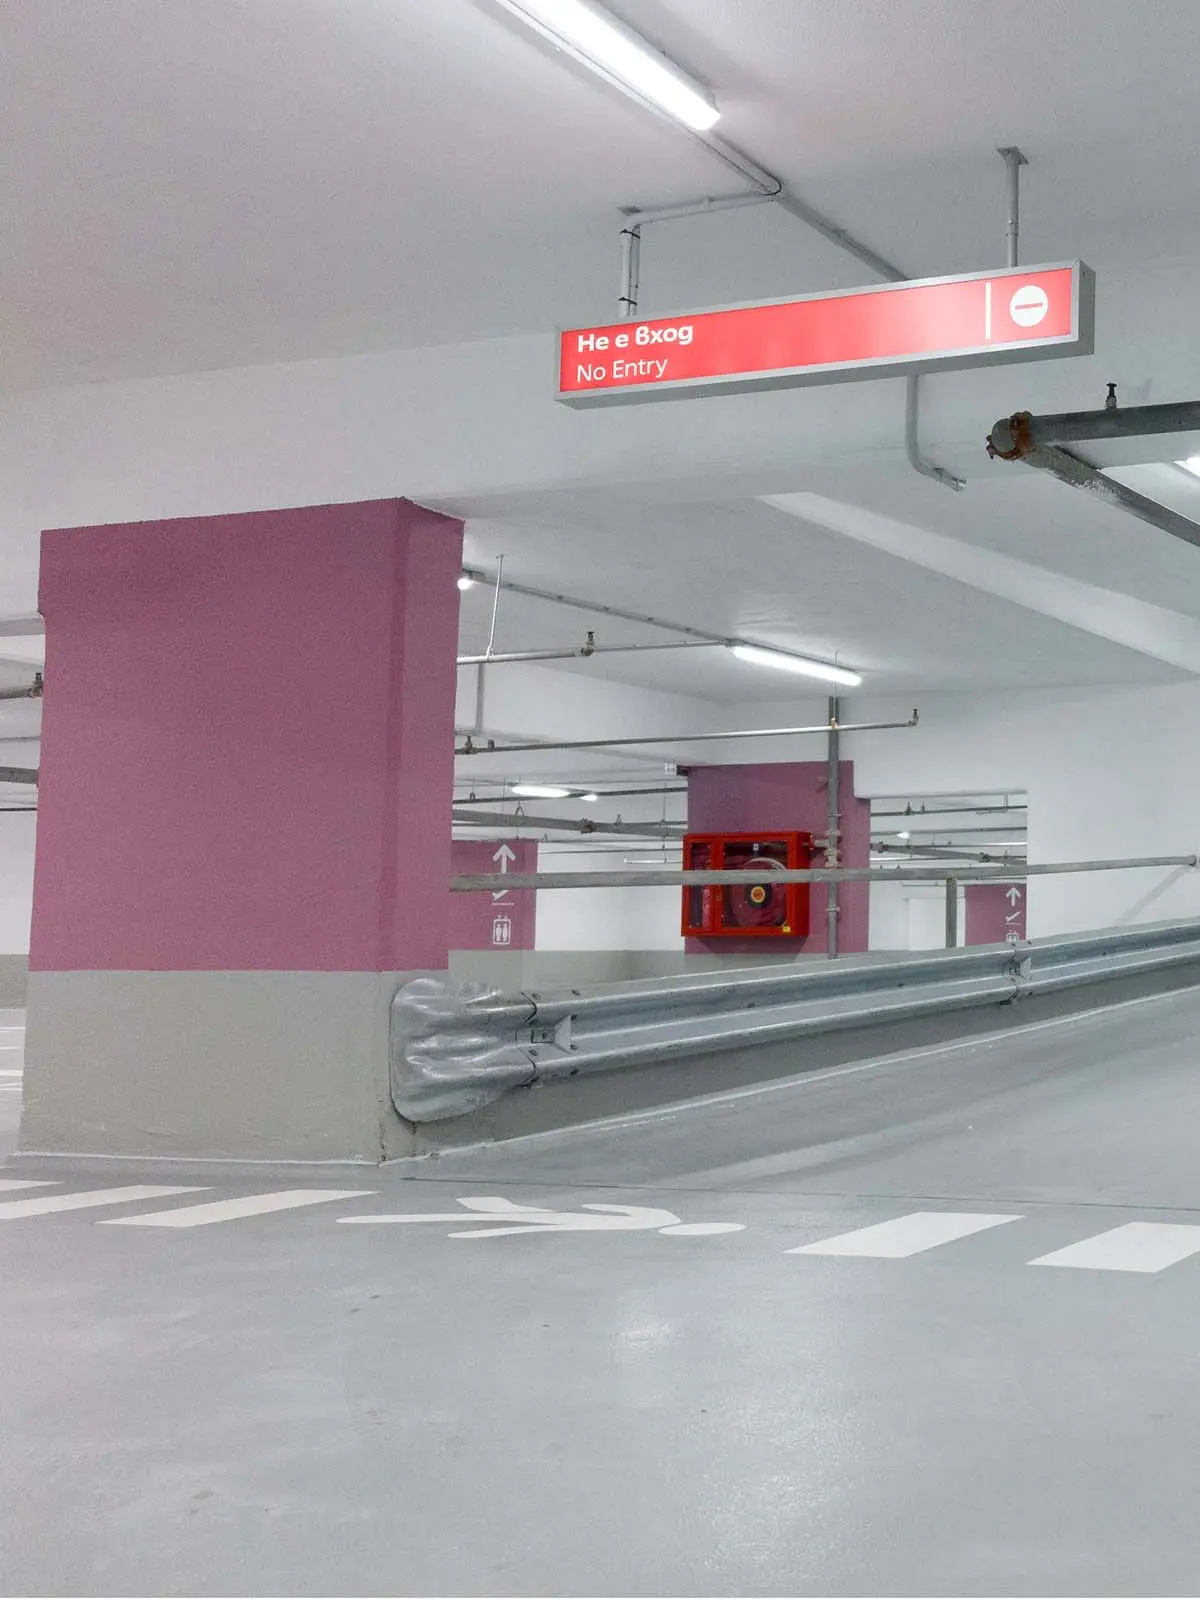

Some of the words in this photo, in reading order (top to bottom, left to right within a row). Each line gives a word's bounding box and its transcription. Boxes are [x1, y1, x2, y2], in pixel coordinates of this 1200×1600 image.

[577, 334, 609, 353] Не
[615, 333, 629, 348] е
[577, 363, 606, 383] No
[613, 358, 668, 379] Entry
